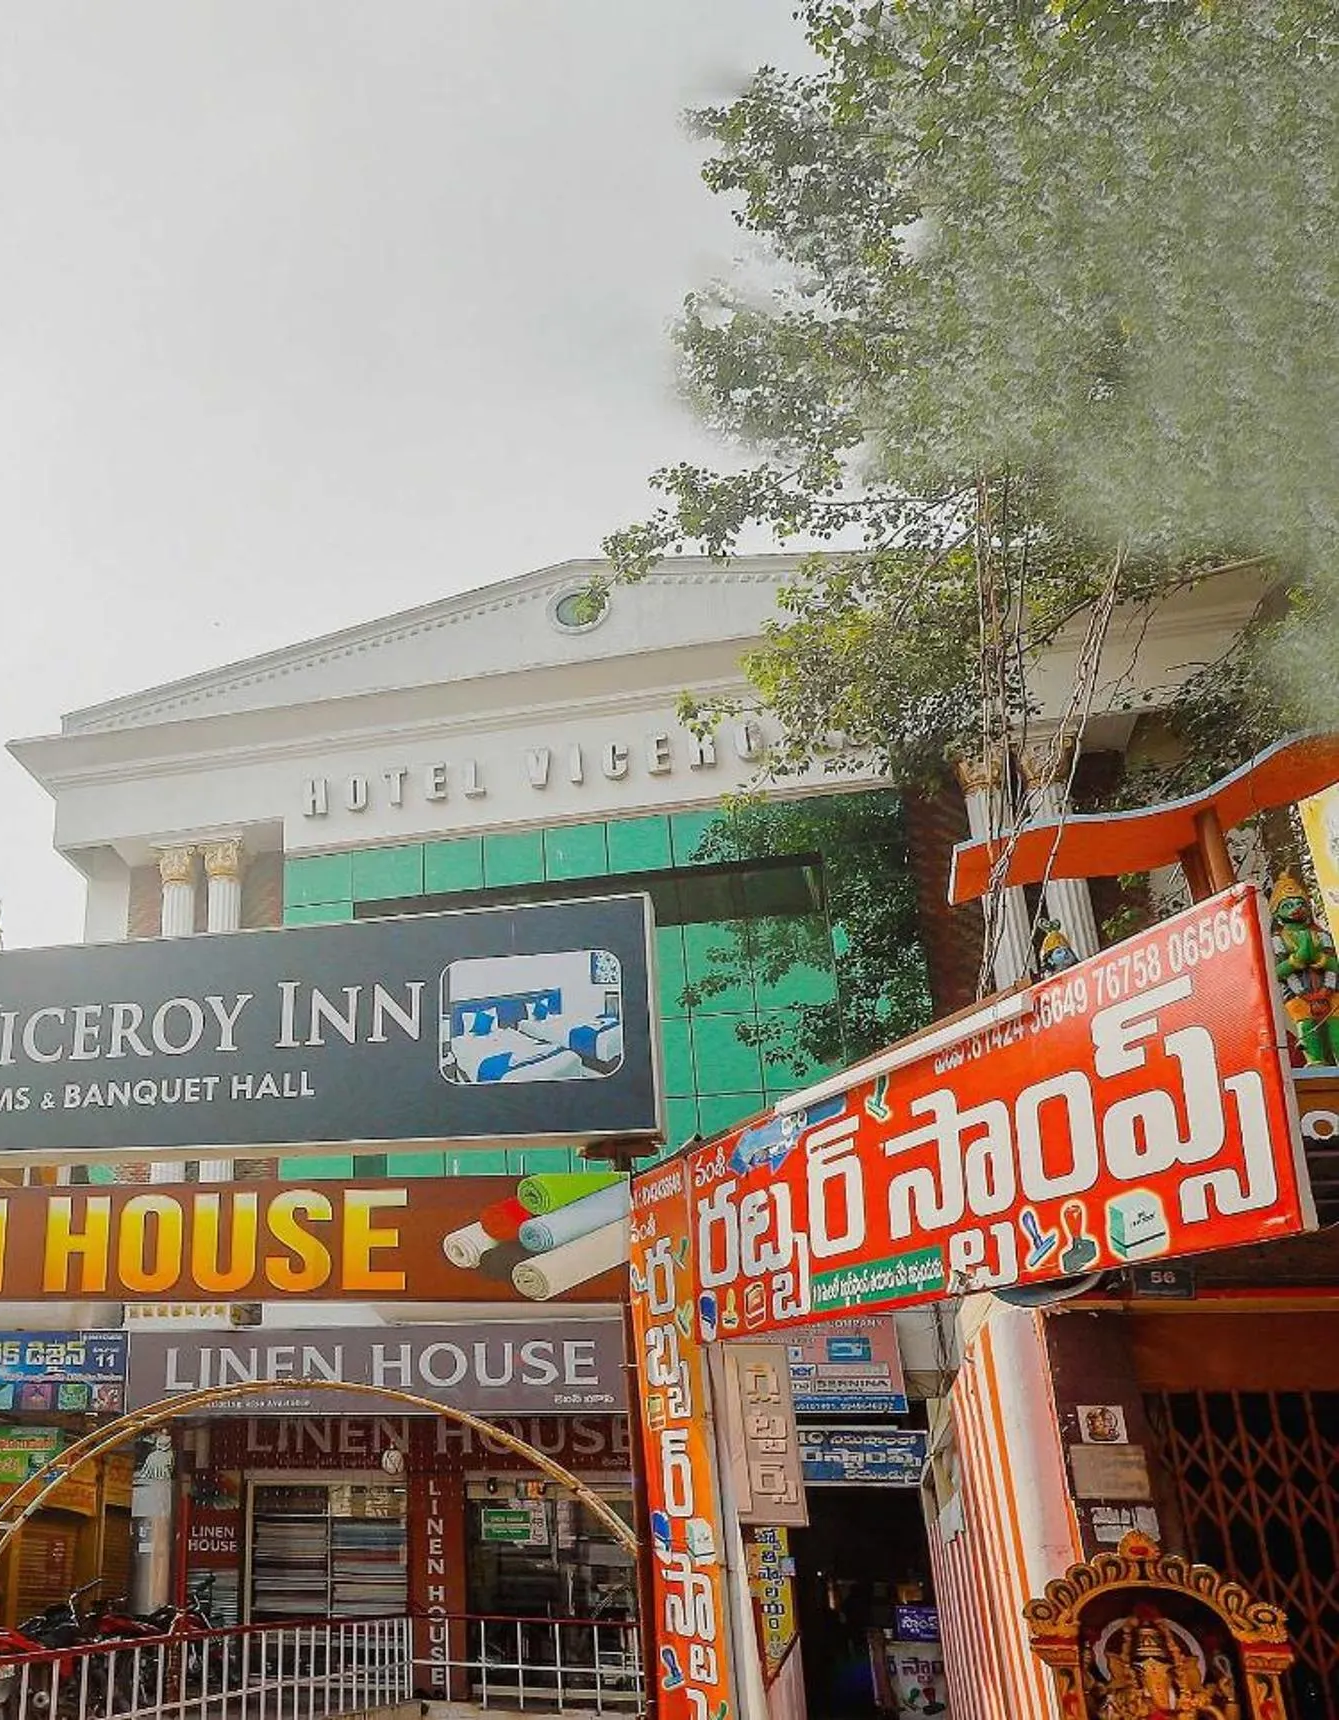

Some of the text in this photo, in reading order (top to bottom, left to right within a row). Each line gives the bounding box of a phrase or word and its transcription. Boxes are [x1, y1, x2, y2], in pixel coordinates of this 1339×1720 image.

[303, 719, 768, 816] HOTEL VICERO
[1030, 976, 1088, 1034] 36649
[1090, 943, 1162, 1005] 76758
[1166, 905, 1248, 974] 06566
[274, 980, 426, 1050] INN
[42, 1091, 56, 1109] &
[62, 1075, 221, 1110] BANQUET
[232, 1070, 316, 1101] HALL
[43, 1187, 409, 1293] HOUSE
[696, 1113, 867, 1321] రబ్బర్
[95, 1353, 115, 1368] 11
[165, 1339, 600, 1392] LINEN HOUSE
[246, 1416, 411, 1454] LINEN
[187, 1539, 238, 1552] HOUSE
[191, 1525, 235, 1539] LINEN
[427, 1479, 447, 1686] LINEN HOUSE
